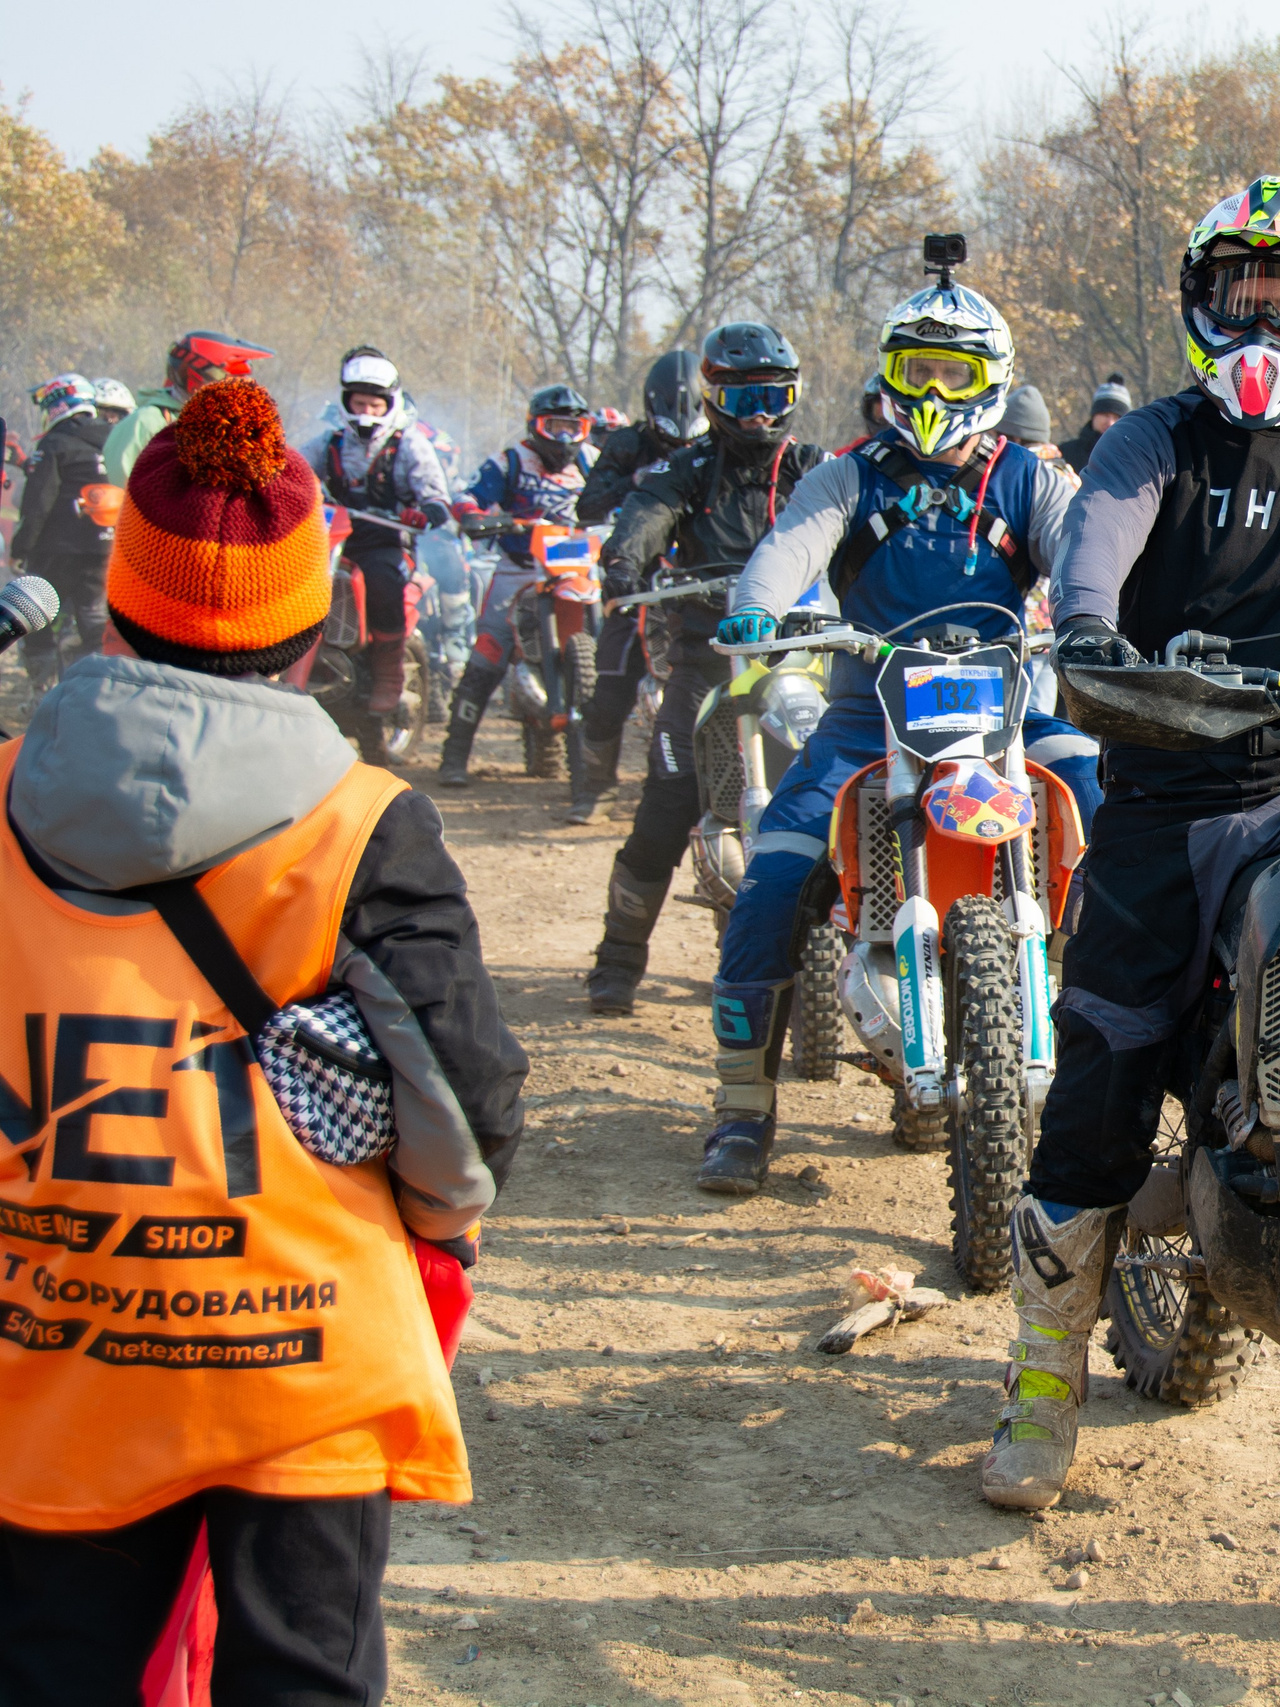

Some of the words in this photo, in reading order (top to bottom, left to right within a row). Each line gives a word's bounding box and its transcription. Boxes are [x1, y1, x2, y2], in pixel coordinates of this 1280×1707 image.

[931, 681, 978, 711] 132
[660, 731, 679, 773] USWE
[901, 977, 917, 1049] MOTOREX
[146, 1225, 235, 1250] SHOP
[33, 1264, 338, 1321] ОБОРУДОВАНИЯ
[105, 1336, 304, 1363] netextreme.ru
